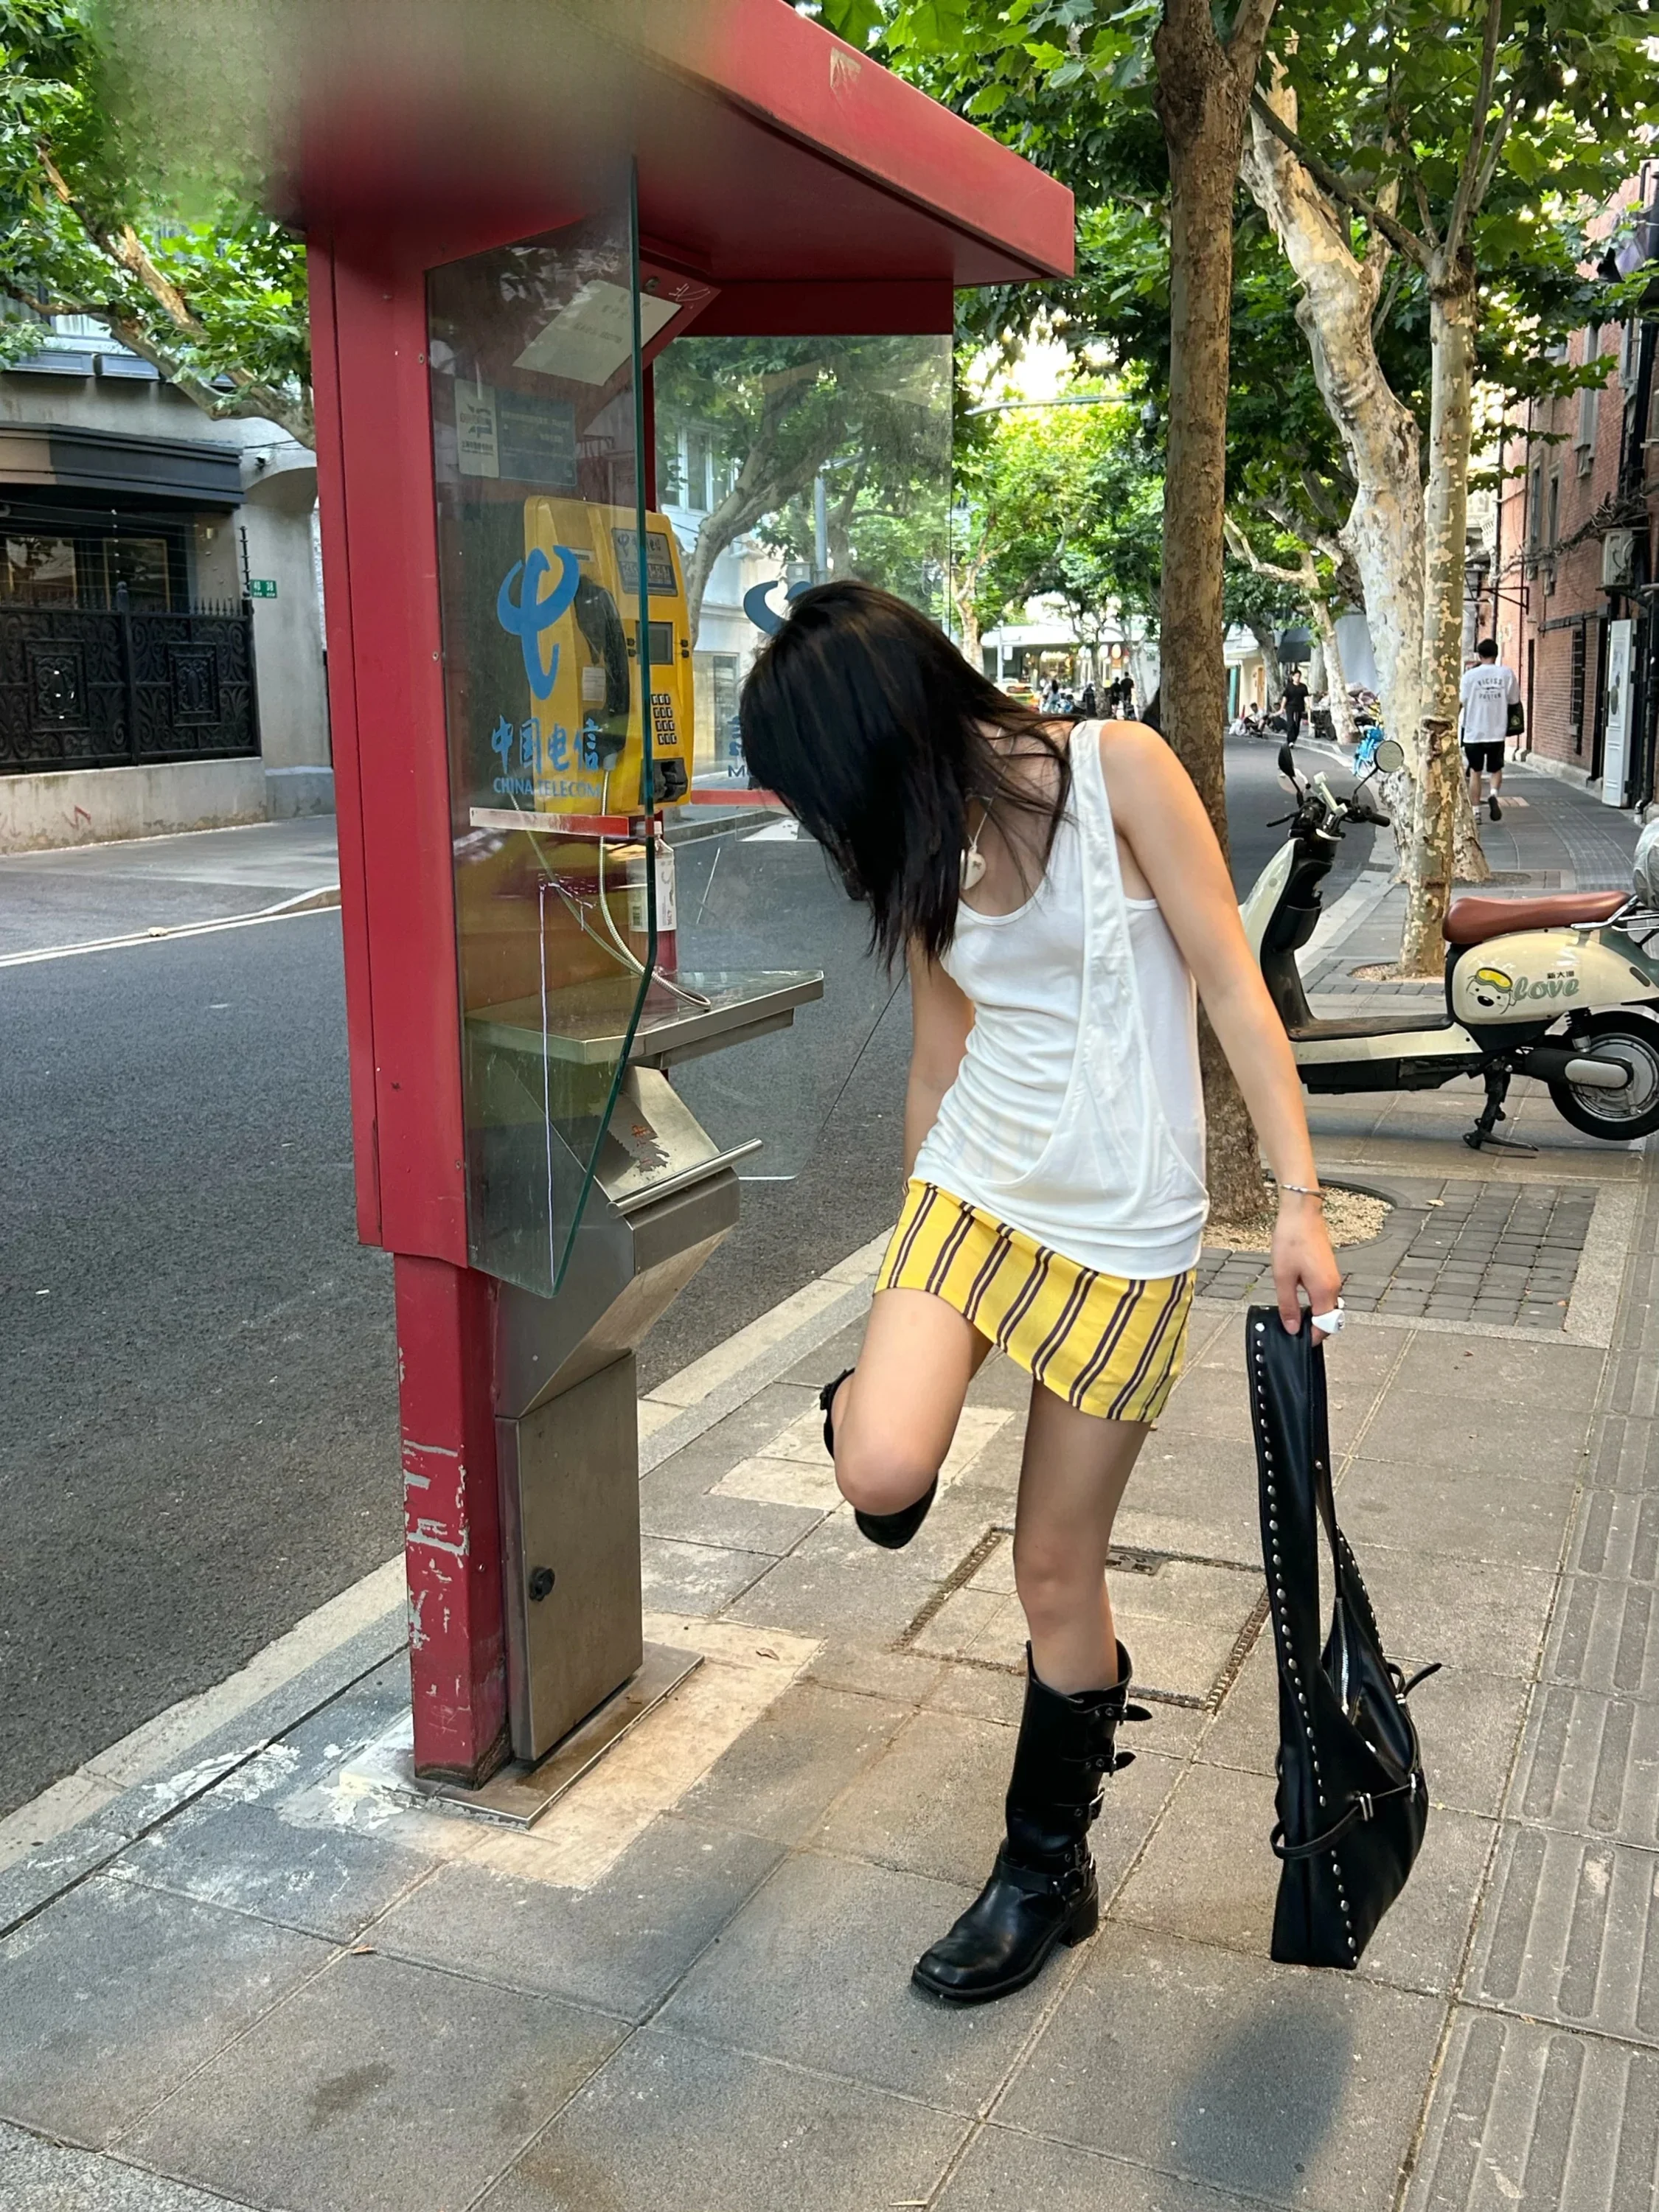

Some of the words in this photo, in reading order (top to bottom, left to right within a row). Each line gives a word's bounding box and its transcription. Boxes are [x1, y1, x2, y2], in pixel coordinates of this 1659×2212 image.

[491, 714, 602, 774] 中国电信
[493, 776, 534, 794] CHINA
[538, 779, 602, 798] TELECOM
[1512, 975, 1579, 1001] love
